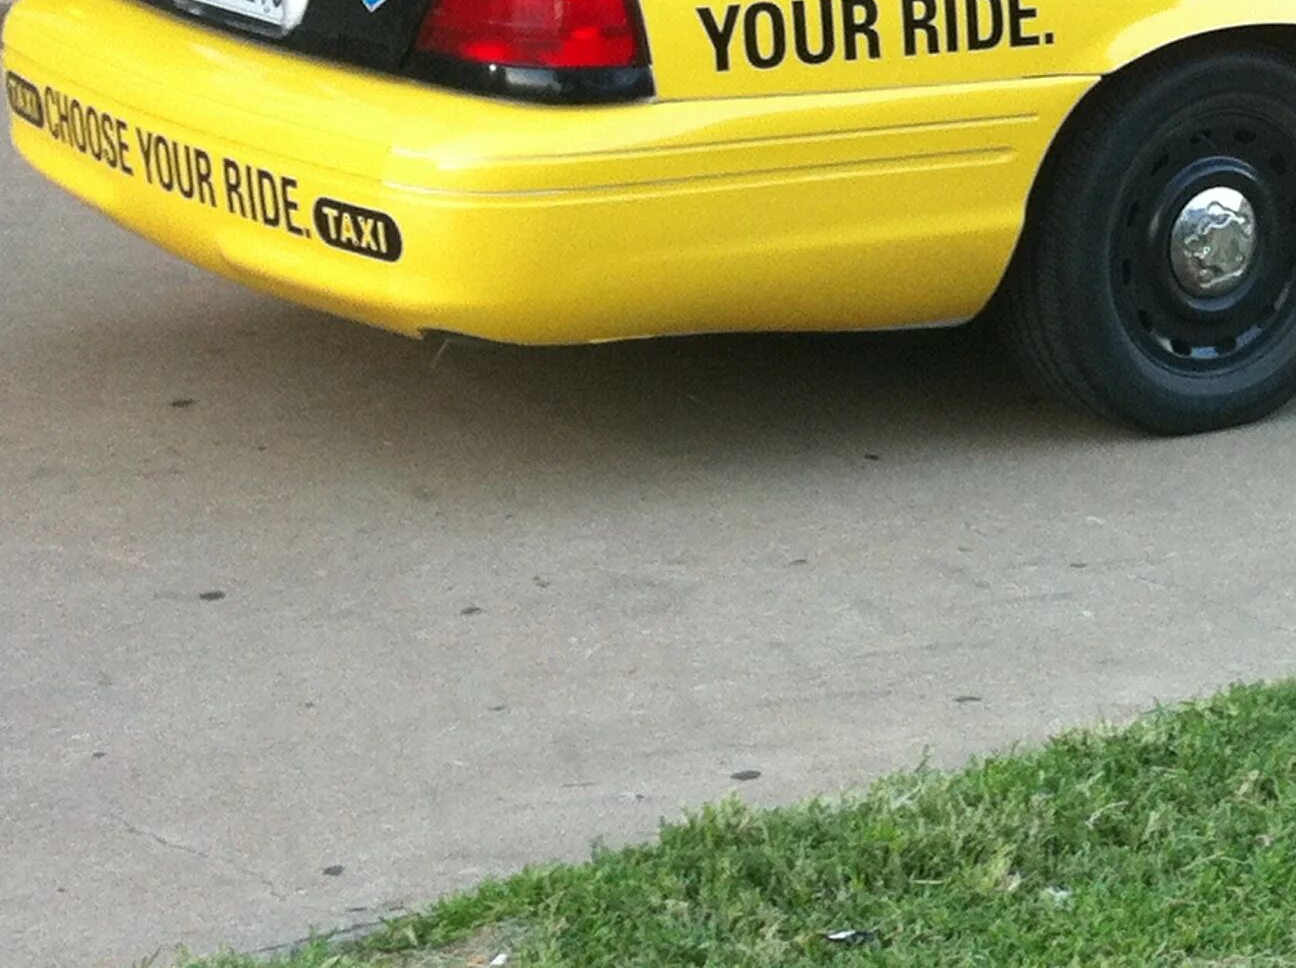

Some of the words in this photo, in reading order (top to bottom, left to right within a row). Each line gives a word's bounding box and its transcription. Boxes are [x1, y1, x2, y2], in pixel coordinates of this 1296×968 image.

[44, 85, 134, 177] CHOOSE
[136, 126, 218, 208] YOUR
[223, 157, 312, 239] RIDE.
[321, 206, 389, 254] TAXI
